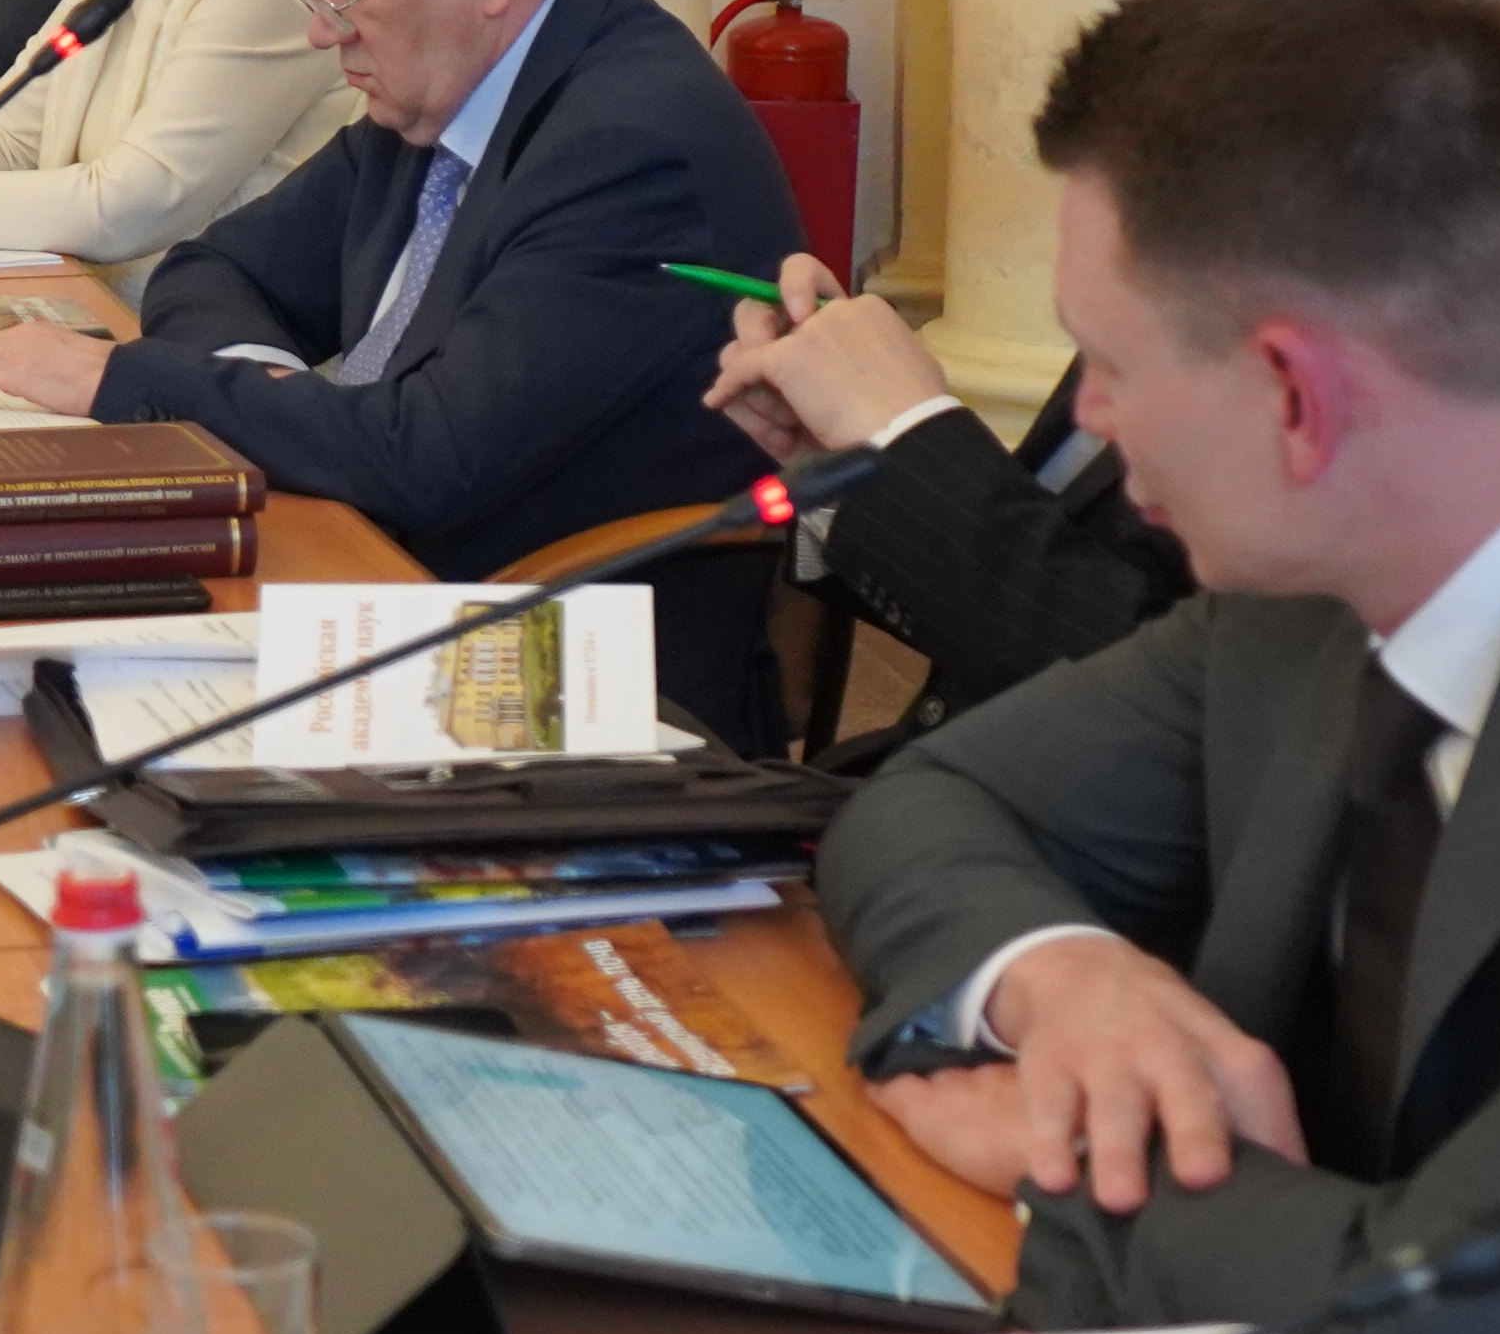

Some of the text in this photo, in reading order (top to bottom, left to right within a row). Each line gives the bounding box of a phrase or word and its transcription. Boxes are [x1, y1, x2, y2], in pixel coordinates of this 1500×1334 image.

[309, 620, 336, 733] Россйская
[353, 601, 381, 750] академя наук
